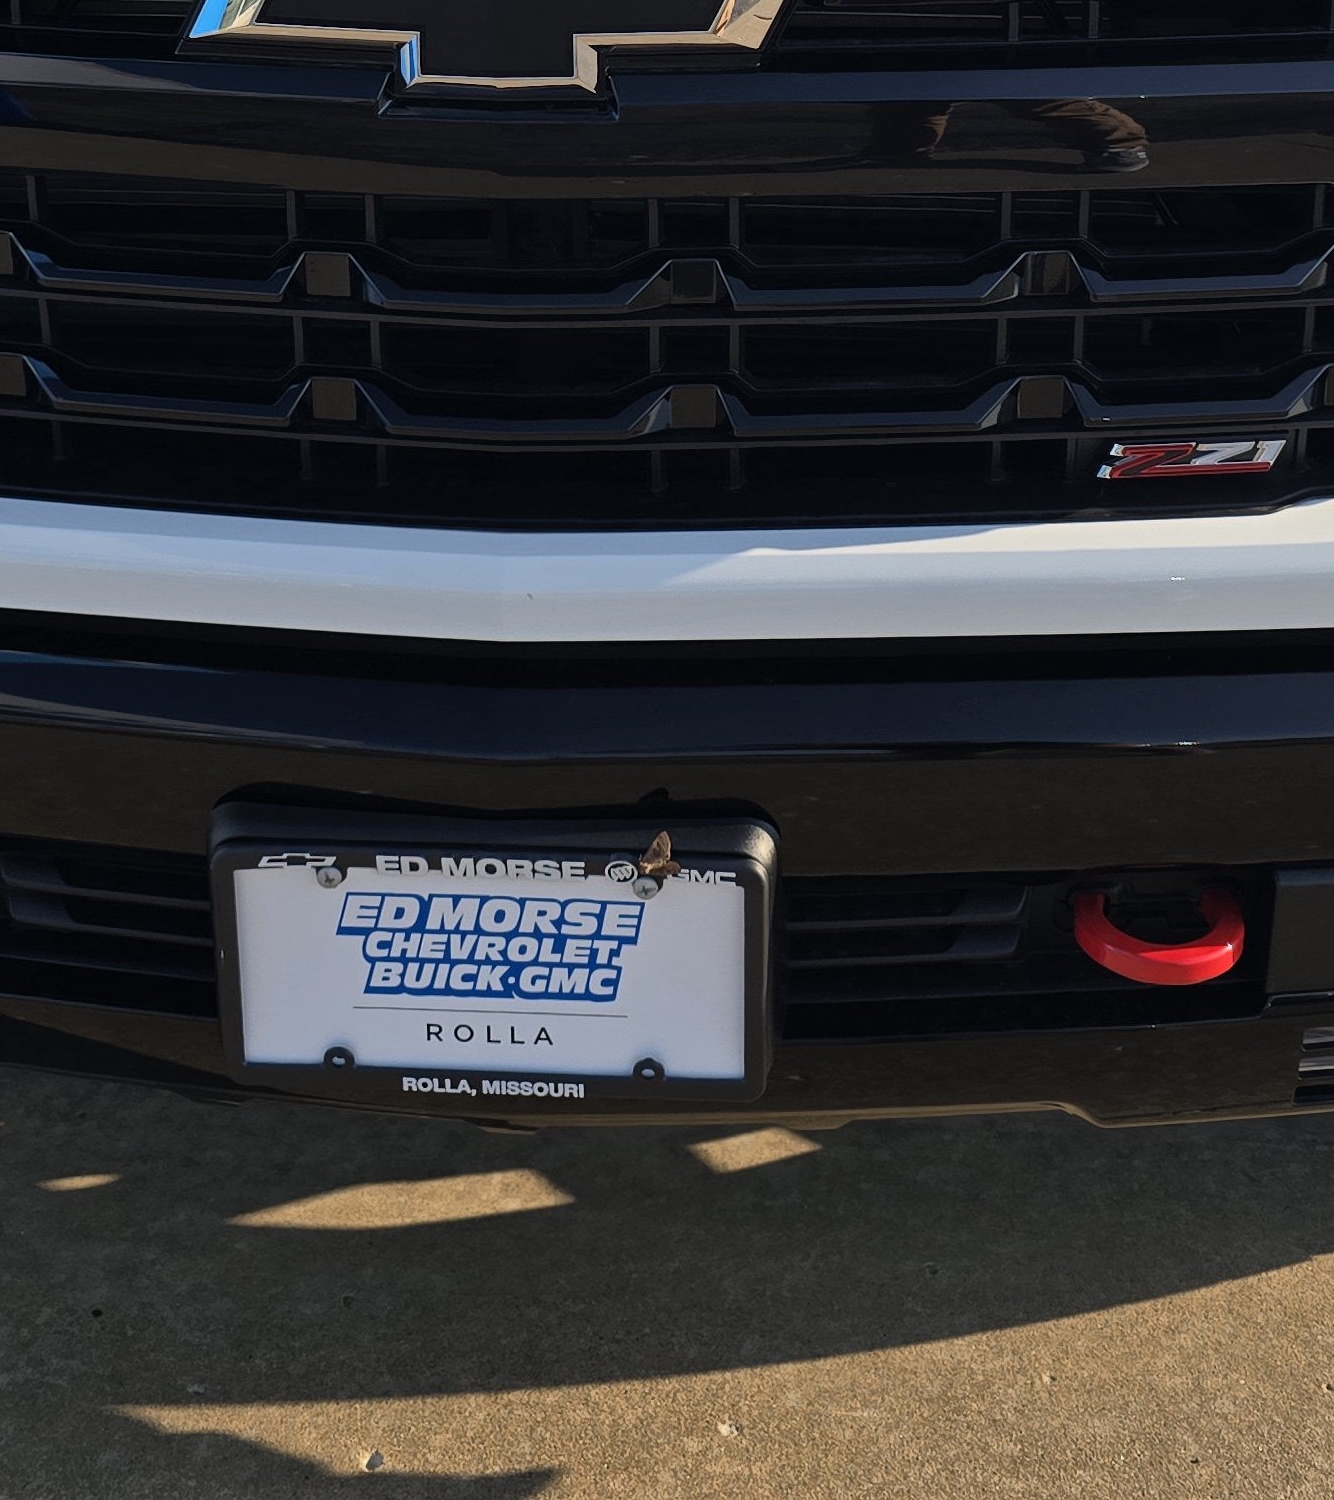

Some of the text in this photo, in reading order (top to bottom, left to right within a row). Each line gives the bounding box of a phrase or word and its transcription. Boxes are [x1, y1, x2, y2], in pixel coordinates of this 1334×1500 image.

[1097, 440, 1286, 479] Z71
[375, 855, 586, 881] ED MORSE
[340, 895, 642, 937] ED MORSE
[426, 1023, 553, 1045] ROLLA
[402, 1077, 585, 1098] ROLLA, MISSOURI
